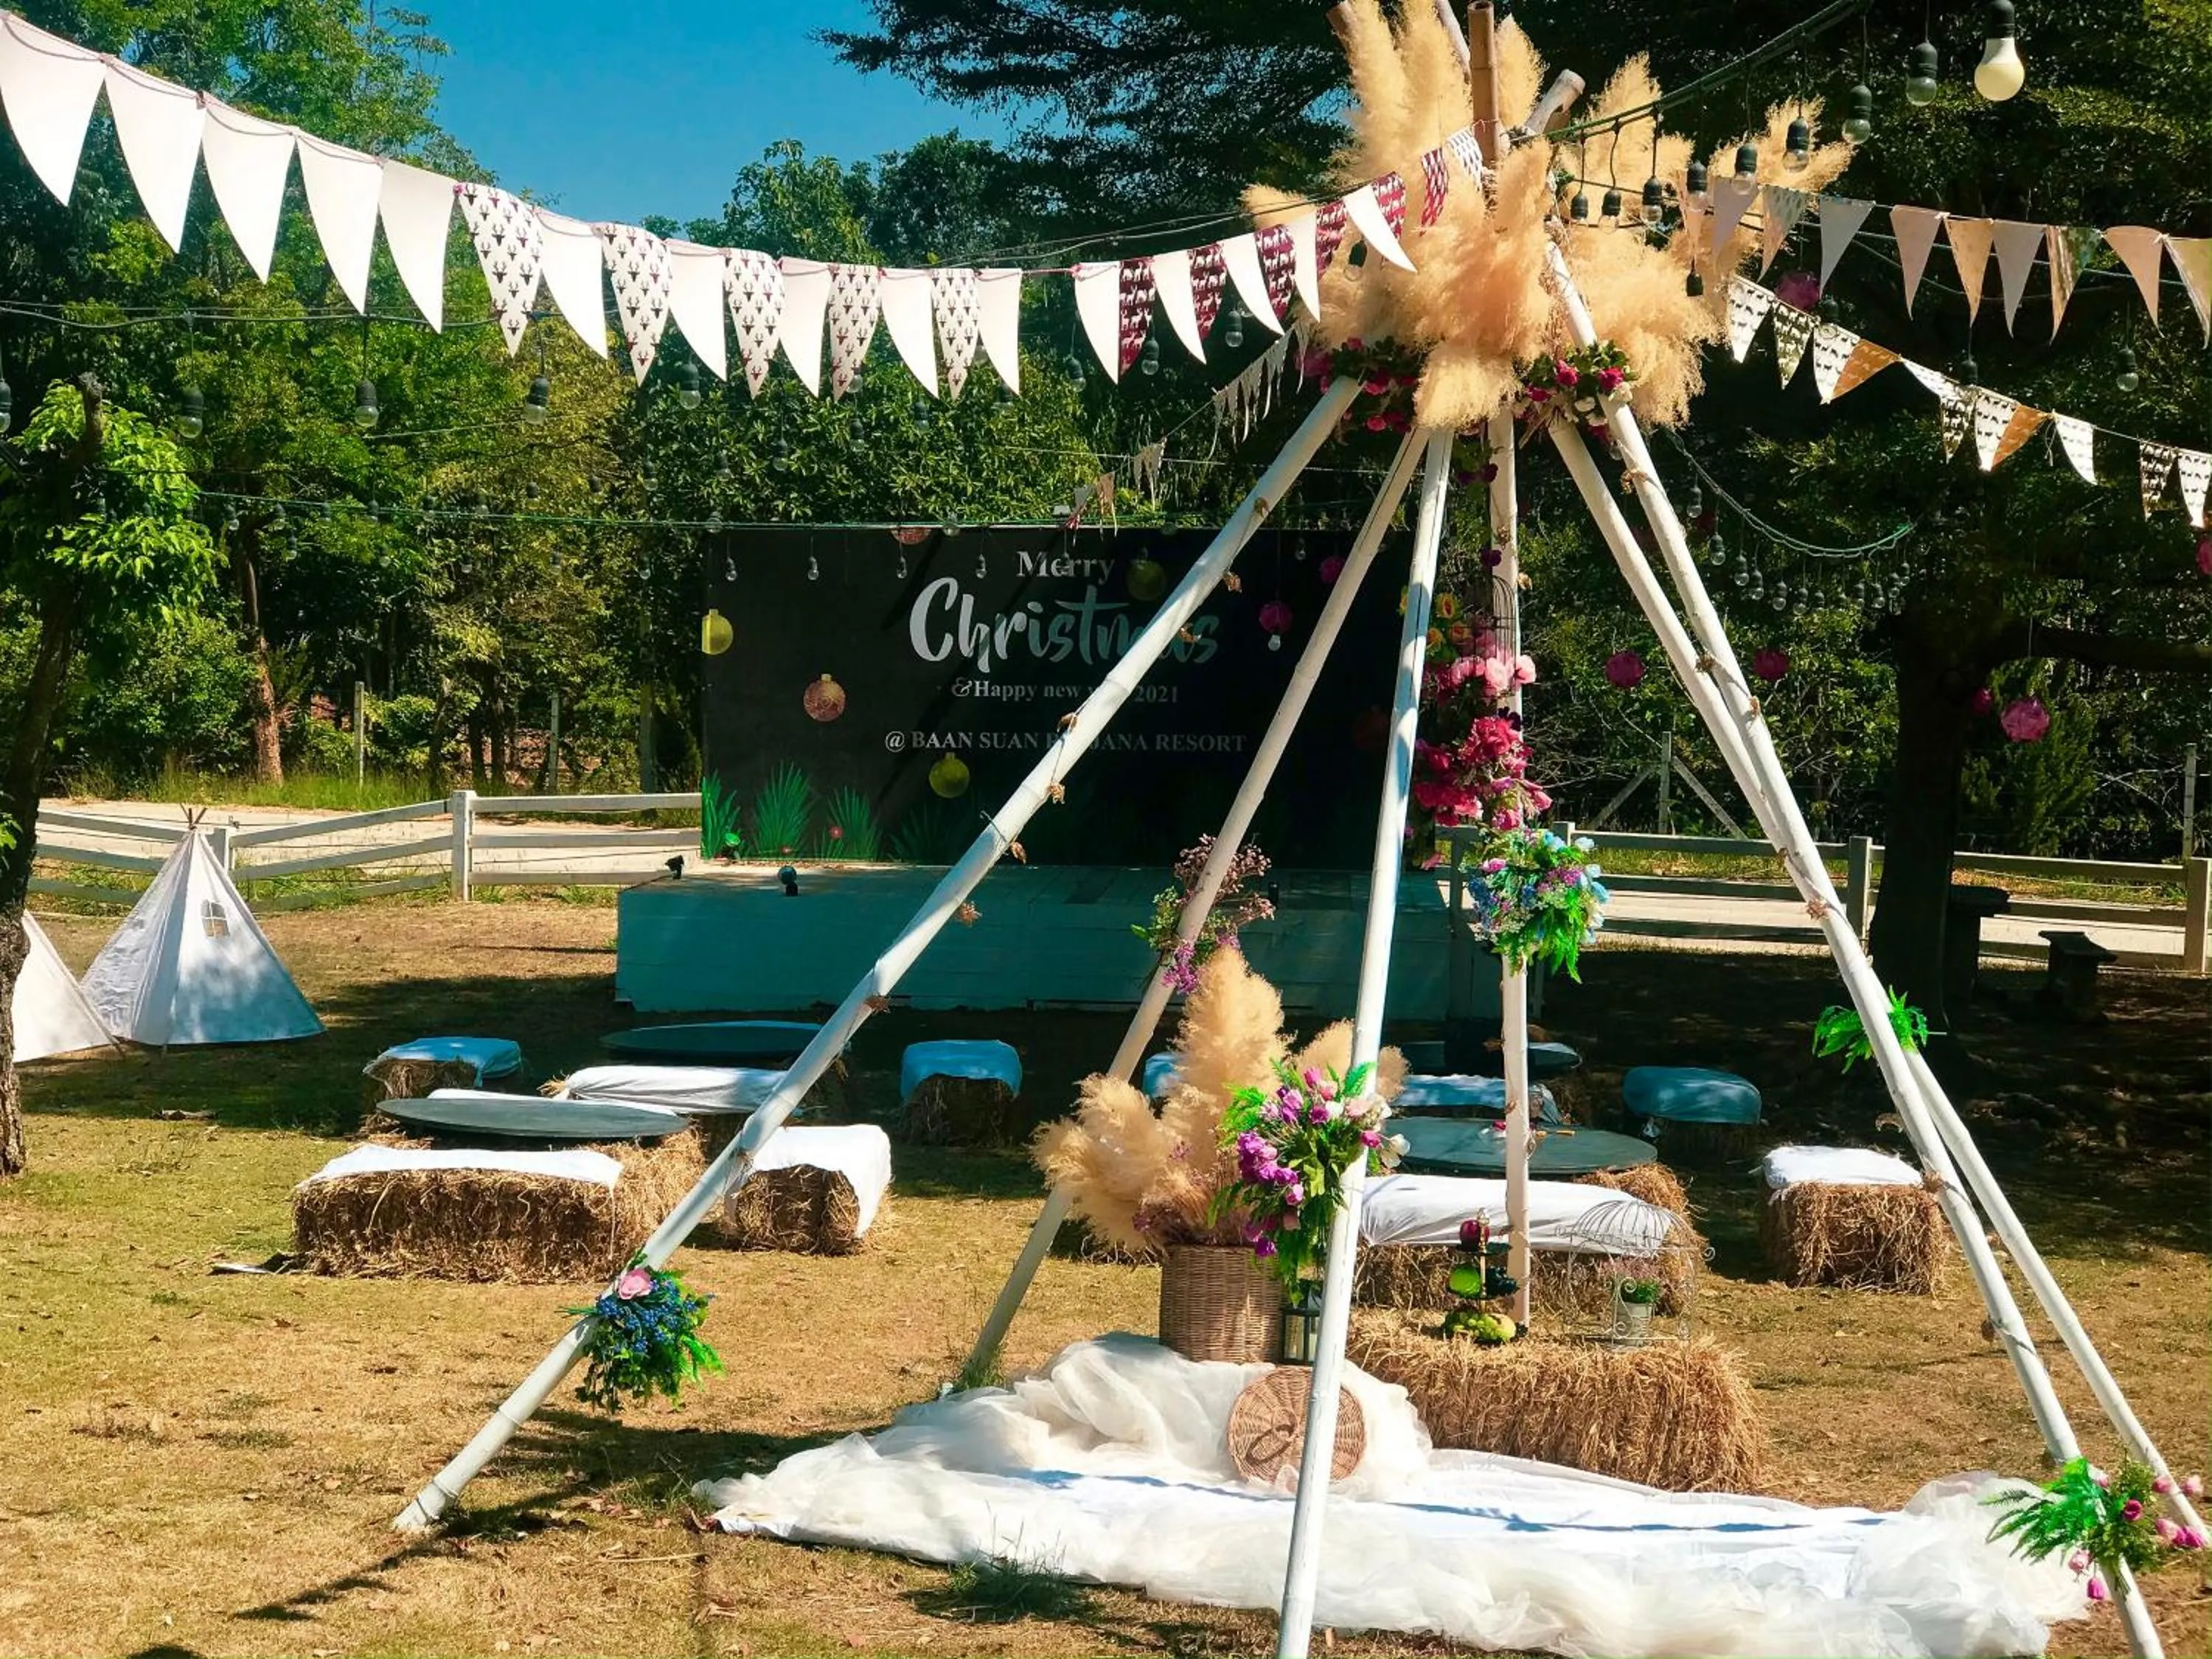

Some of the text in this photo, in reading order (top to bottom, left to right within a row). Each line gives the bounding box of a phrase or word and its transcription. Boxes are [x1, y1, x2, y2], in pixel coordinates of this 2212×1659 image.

[1016, 550, 1116, 585] Merry
[1043, 684, 1082, 698] new
[1133, 684, 1178, 703] 2021
[884, 730, 906, 754] @
[910, 731, 973, 749] BAAN
[979, 731, 1039, 750] SUAN
[1155, 733, 1248, 752] RESORT
